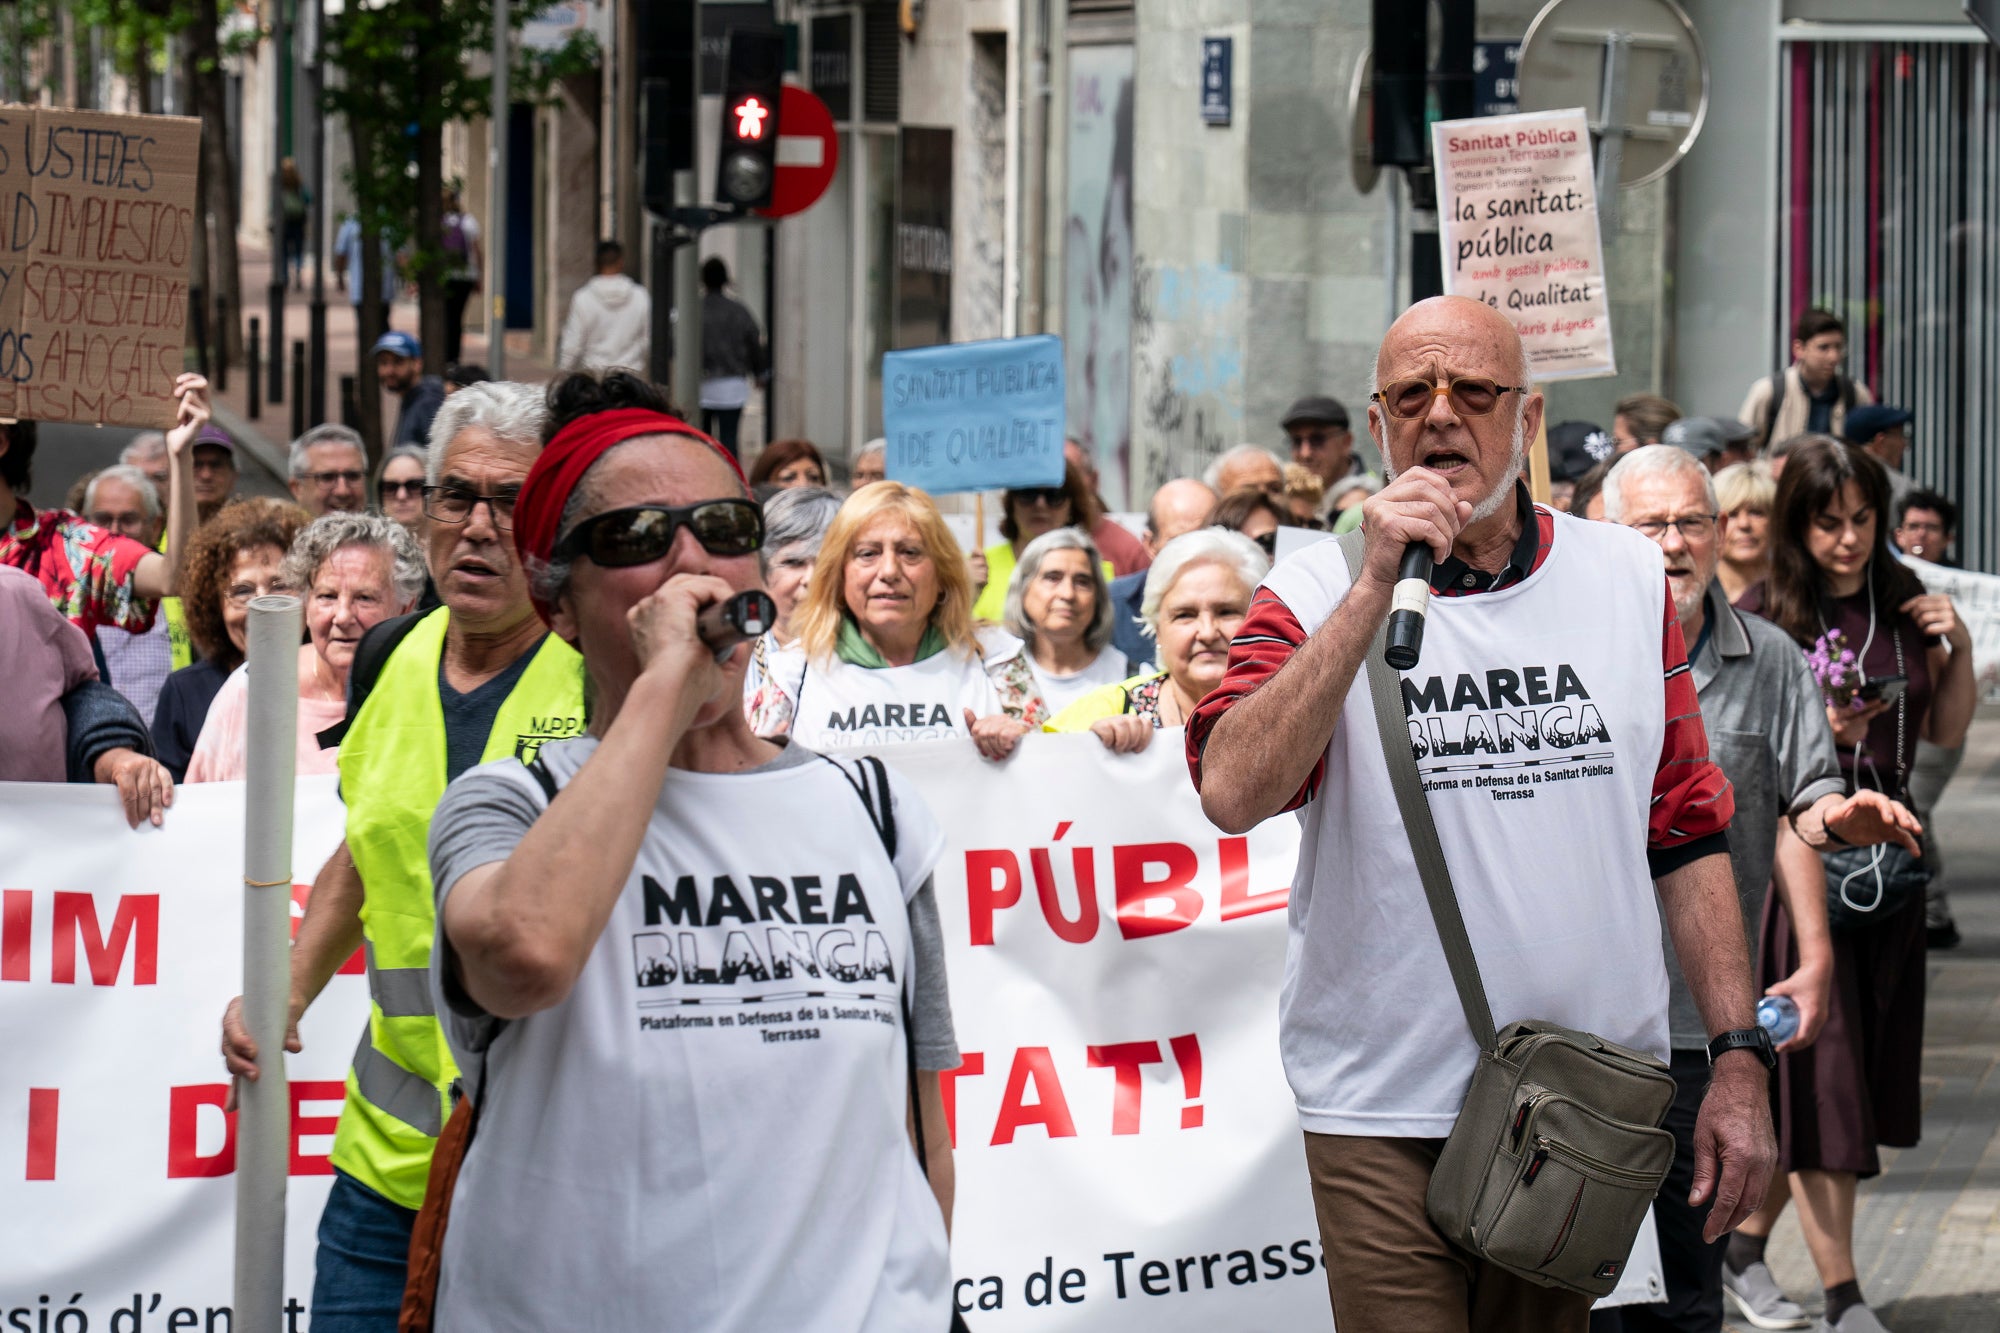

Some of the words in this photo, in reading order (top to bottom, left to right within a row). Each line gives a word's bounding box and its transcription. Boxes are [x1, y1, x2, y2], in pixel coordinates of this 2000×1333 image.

[25, 125, 156, 192] USTEDES
[1449, 136, 1511, 152] Sanitat
[1517, 129, 1577, 146] Pública
[1455, 197, 1476, 222] la
[1487, 188, 1583, 219] sanitat:
[40, 190, 192, 267] IMPUESTOS
[1457, 225, 1553, 271] pública
[1543, 258, 1589, 277] pública
[1507, 283, 1592, 312] Qualitat
[1552, 316, 1596, 337] dignes
[893, 368, 968, 409] SANITAT
[975, 360, 1059, 398] PUBLICA
[946, 417, 1056, 465] QUALITAT
[1401, 664, 1592, 715] MAREA
[827, 703, 953, 732] MAREA
[1406, 703, 1613, 761] BLANCA
[1421, 778, 1459, 792] aforma
[1462, 776, 1473, 788] en
[1475, 772, 1514, 788] Defensa
[1517, 773, 1530, 785] de
[1532, 772, 1542, 783] la
[1544, 769, 1580, 782] Sanitat
[1581, 764, 1614, 777] Pública
[1491, 788, 1535, 801] Terrassa
[642, 872, 876, 927] MAREA
[632, 927, 897, 988] BLANCA
[640, 1015, 714, 1031] Plataforma
[718, 1015, 734, 1026] en
[738, 1009, 793, 1025] Defensa
[797, 1007, 814, 1021] de
[818, 1006, 829, 1020] la
[760, 1028, 821, 1043] Terrassa
[0, 1292, 89, 1333] sió
[1024, 1256, 1087, 1307] de
